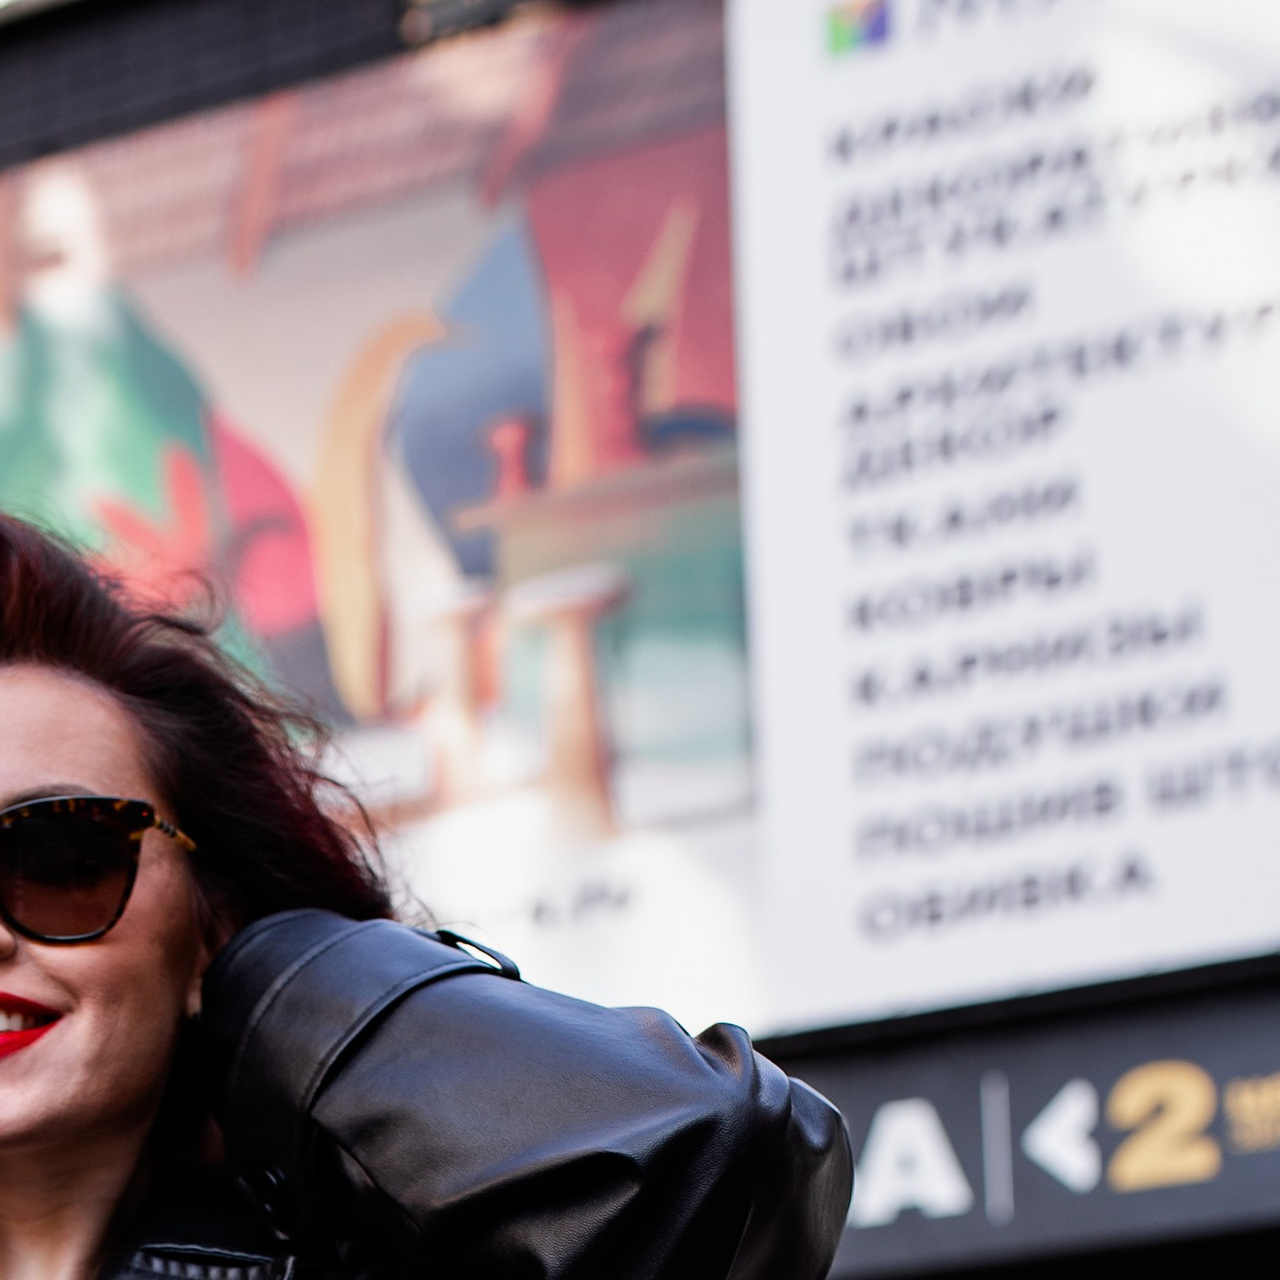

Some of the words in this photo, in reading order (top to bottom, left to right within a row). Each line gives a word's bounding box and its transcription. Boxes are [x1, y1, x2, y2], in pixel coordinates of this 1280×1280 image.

[852, 546, 1096, 630] КОВРЫ
[855, 676, 1226, 786] ПОДУШКИ
[856, 778, 1126, 864] ПОШИВ
[858, 856, 1156, 942] ОБИВКА
[1106, 1058, 1220, 1194] 2
